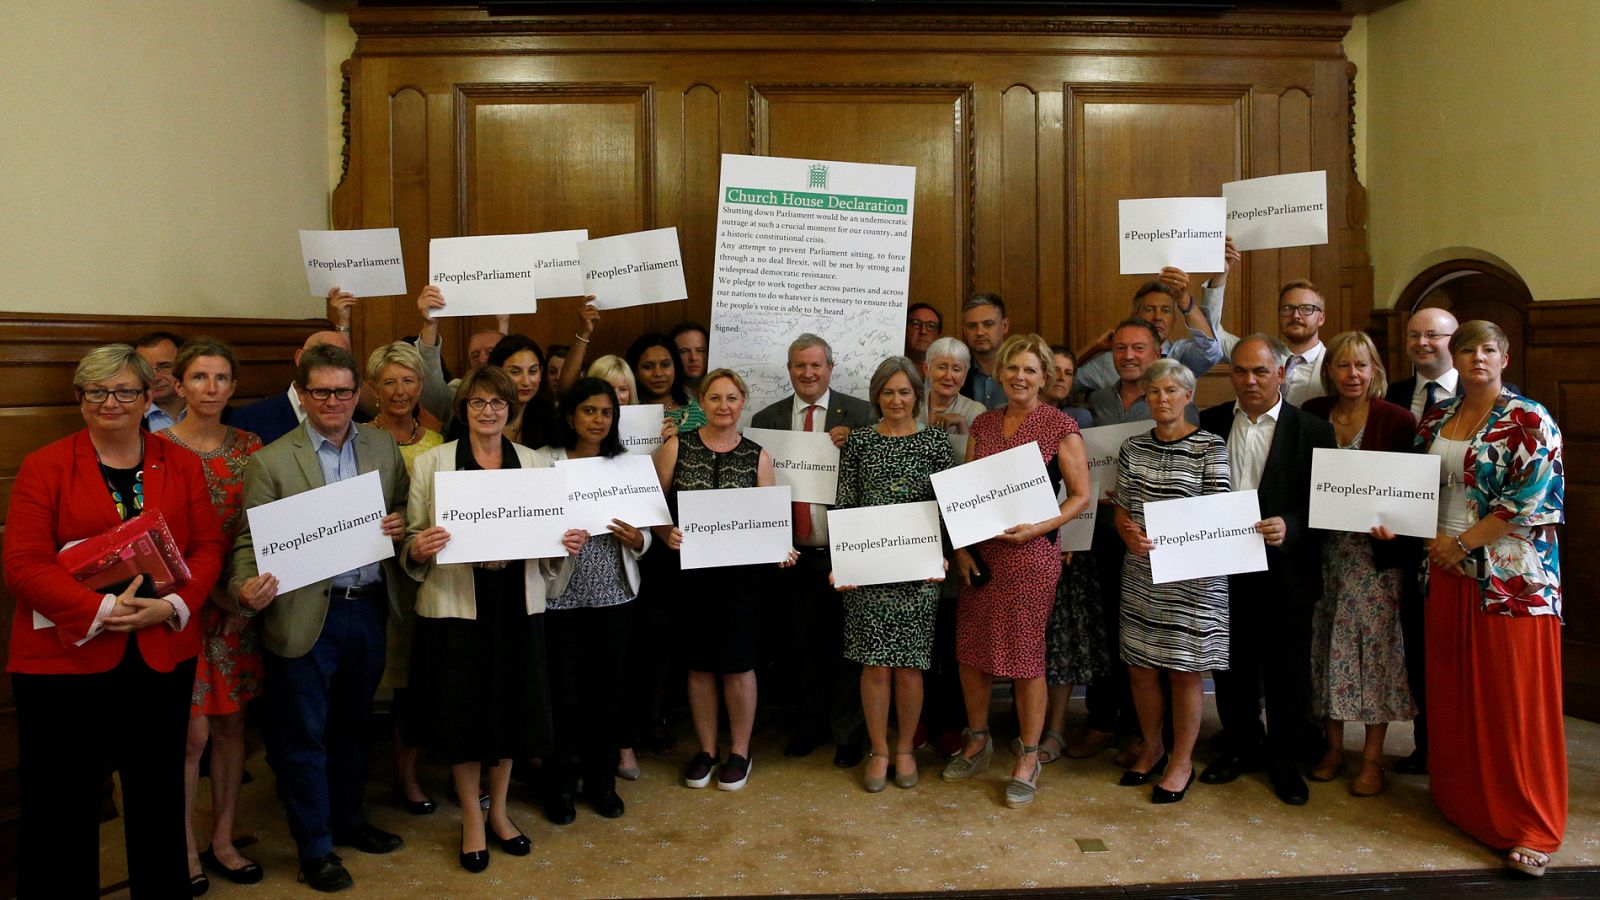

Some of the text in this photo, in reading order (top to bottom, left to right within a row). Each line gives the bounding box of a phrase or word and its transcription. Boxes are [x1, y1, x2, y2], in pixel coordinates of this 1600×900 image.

[728, 189, 905, 213] Church House Declaration
[722, 206, 753, 217] Shutting
[754, 208, 775, 216] down
[776, 209, 814, 219] Parliament
[859, 216, 908, 225] undemocratic
[1227, 203, 1323, 220] #PeoplesParliament
[721, 219, 749, 228] outrage
[726, 230, 753, 238] historic
[755, 233, 804, 242] constitutional
[1125, 229, 1222, 242] #PeoplesParliament
[720, 241, 736, 251] Any
[738, 244, 766, 253] attempt
[809, 247, 848, 256] Parliament
[887, 252, 906, 260] force
[308, 258, 400, 270] #PeoplesParliament
[586, 260, 679, 280] #PeoplesParliament
[719, 253, 748, 263] through
[768, 256, 784, 264] deal
[828, 260, 838, 268] be
[855, 262, 865, 271] by
[867, 264, 890, 273] strong
[719, 265, 759, 275] widespread
[760, 268, 800, 277] democratic
[434, 270, 530, 284] #PeoplesParliament
[718, 276, 731, 284] We
[732, 277, 756, 288] pledge
[787, 282, 817, 291] together
[778, 292, 811, 301] whatever
[819, 297, 854, 306] necessary
[888, 299, 903, 308] that
[716, 301, 729, 309] the
[730, 302, 758, 312] people's
[760, 304, 779, 312] voice
[824, 308, 845, 316] heard.
[714, 324, 740, 333] Signed:
[620, 434, 662, 446] arliament
[773, 458, 836, 472] lesParliament
[568, 484, 660, 501] #PeoplesParliament
[946, 474, 1047, 512] #PeoplesParliament
[1316, 482, 1435, 500] #PeoplesParliament
[442, 506, 564, 522] #PeoplesParliament
[262, 510, 383, 555] #PeoplesParliament
[684, 520, 788, 534] #PeoplesParliament
[836, 534, 938, 552] #PeoplesParliament
